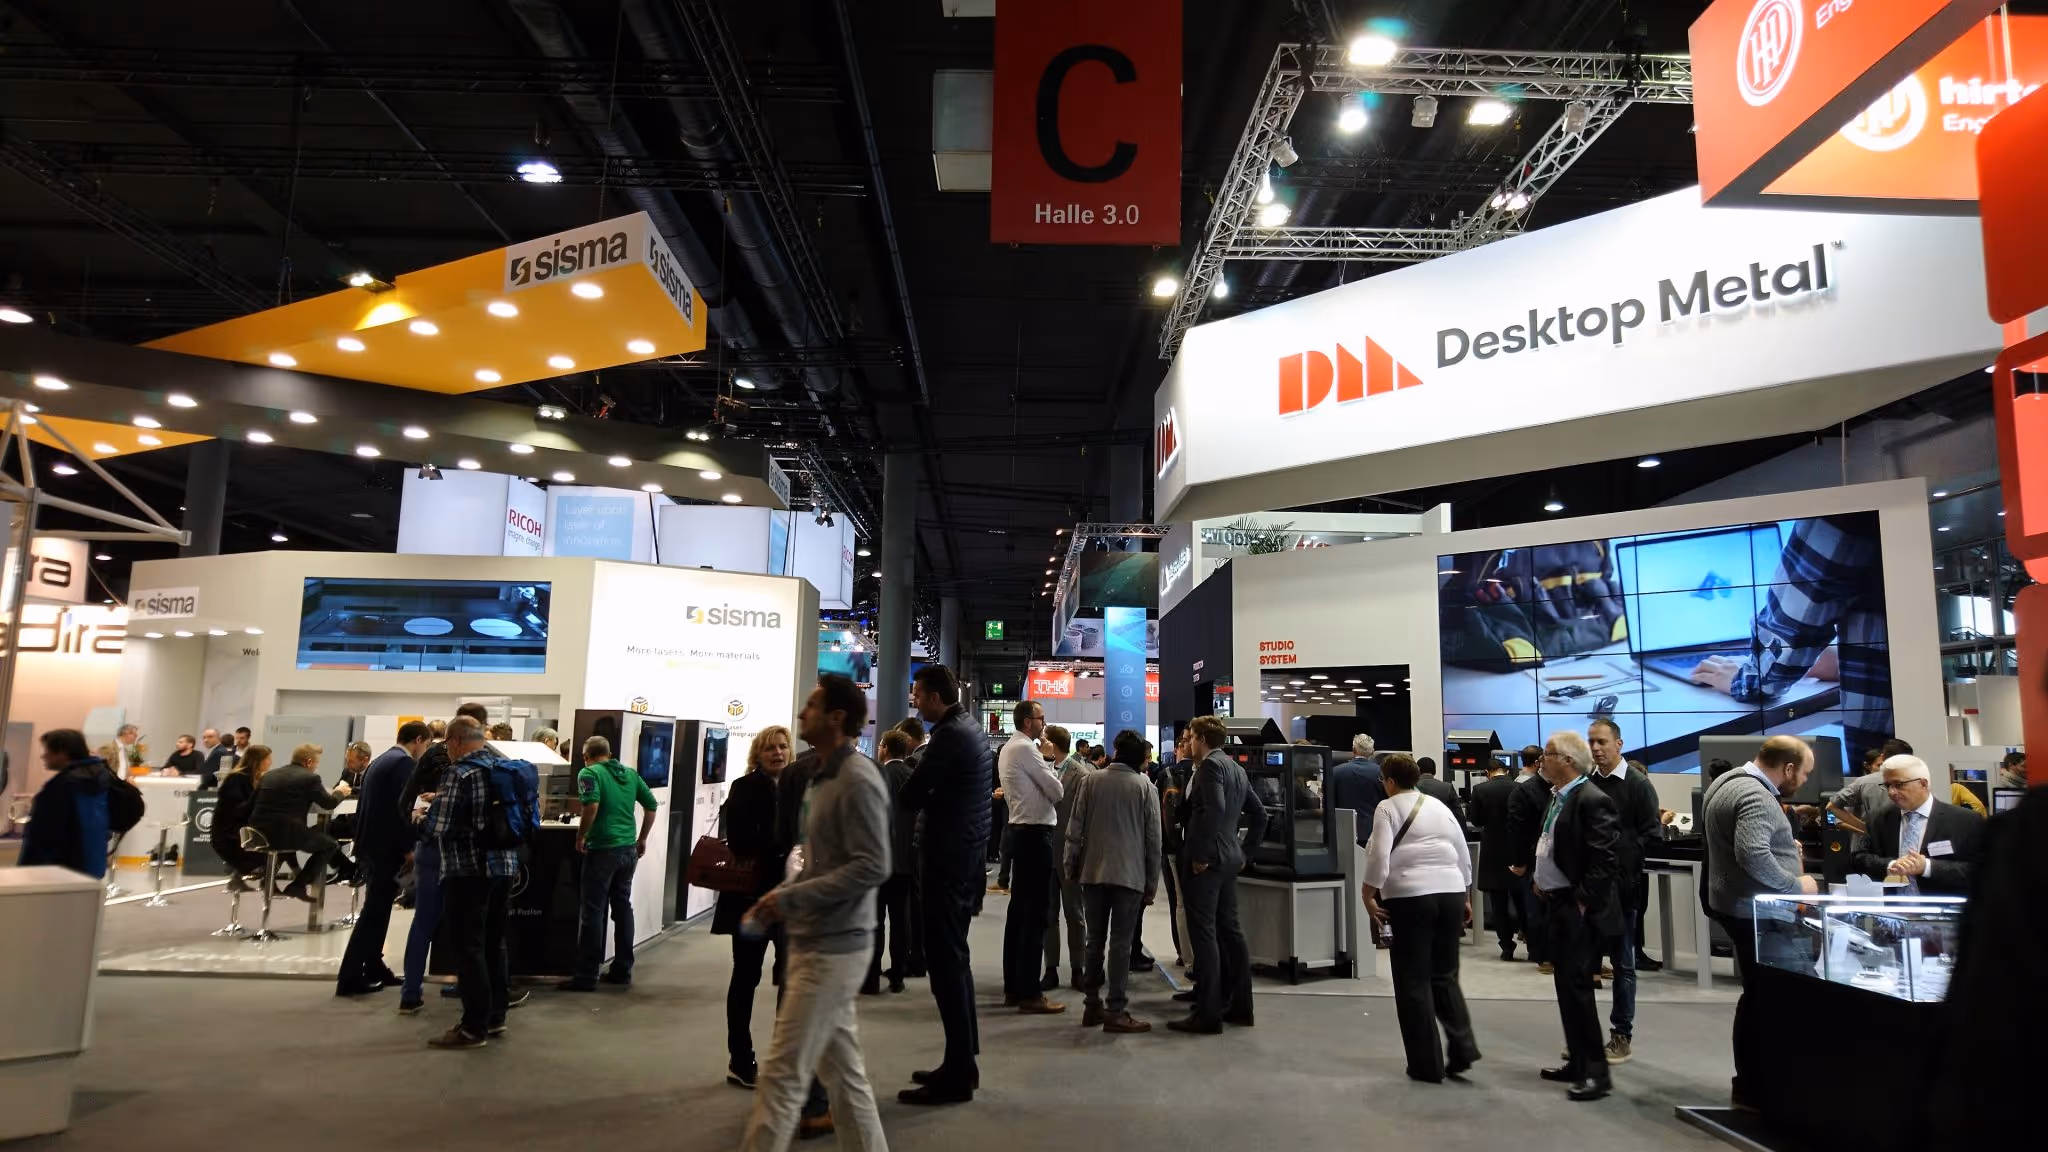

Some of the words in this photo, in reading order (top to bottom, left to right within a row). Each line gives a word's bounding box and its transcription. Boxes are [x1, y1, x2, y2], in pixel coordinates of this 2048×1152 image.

[1036, 43, 1138, 183] C
[1034, 203, 1095, 225] Halle
[1102, 204, 1139, 225] 3.0
[534, 231, 628, 281] sisma
[659, 252, 692, 322] sisma
[1437, 297, 1646, 369] Desktop
[1657, 242, 1829, 323] Metal
[508, 508, 542, 538] RICOH
[146, 592, 196, 616] sisma
[707, 603, 782, 628] sisma
[627, 645, 652, 655] More
[1259, 640, 1295, 651] STUDIO
[1259, 654, 1297, 665] SYSTEM
[1034, 679, 1069, 692] THK
